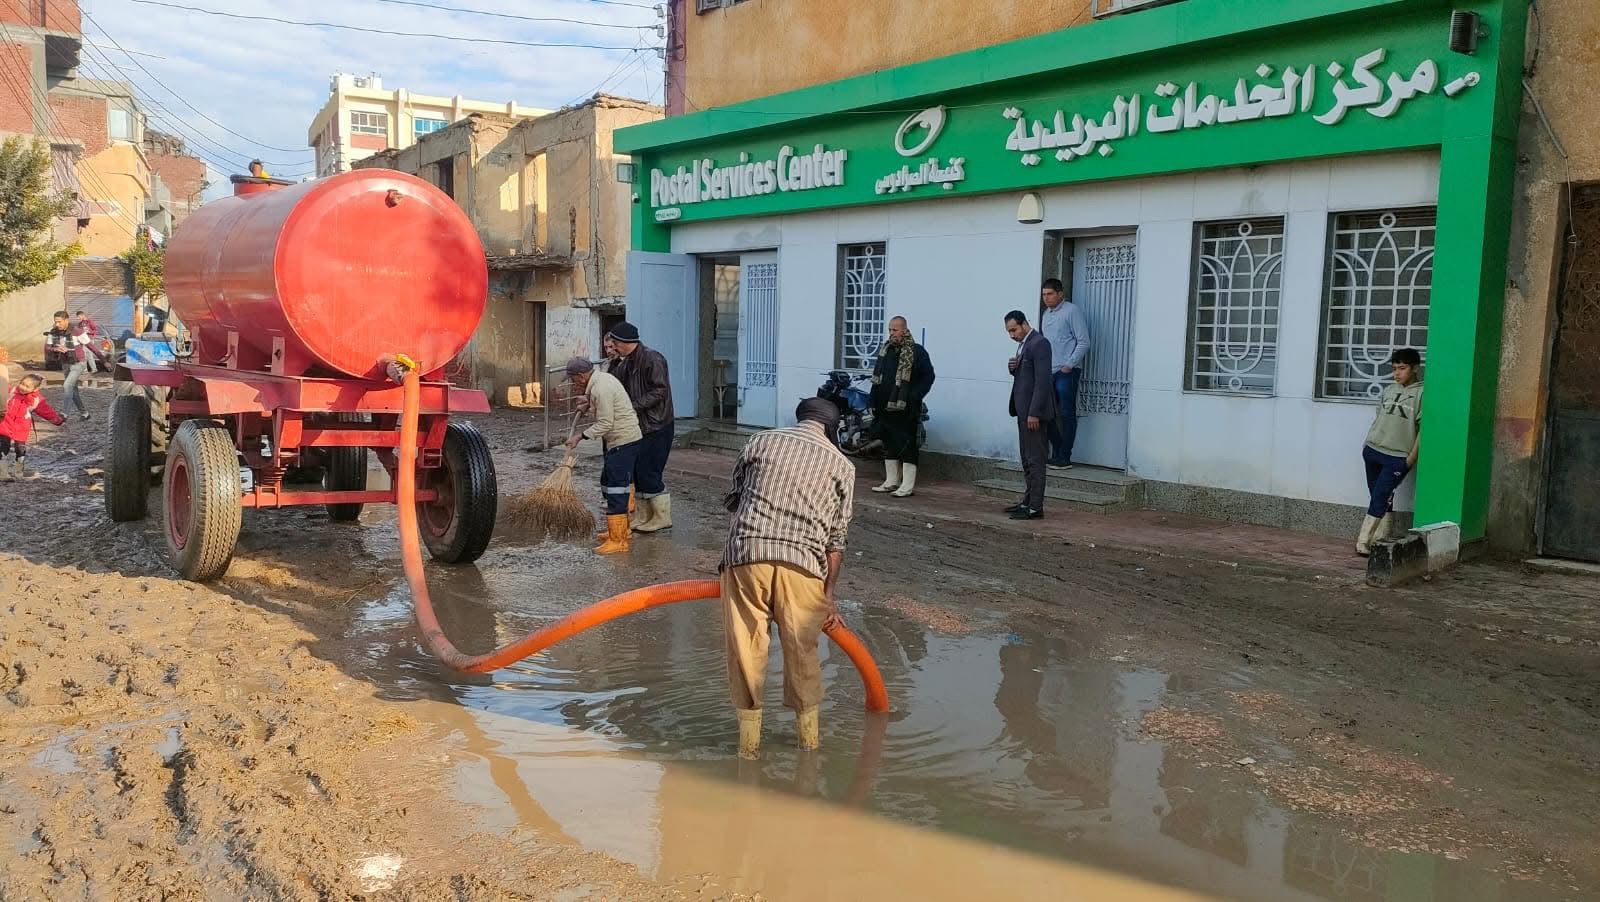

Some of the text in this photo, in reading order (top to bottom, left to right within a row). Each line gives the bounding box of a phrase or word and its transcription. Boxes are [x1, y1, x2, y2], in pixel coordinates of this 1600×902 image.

[1002, 48, 1438, 167] مركز الخدمات البريدية
[651, 143, 848, 208] Postal Services Center
